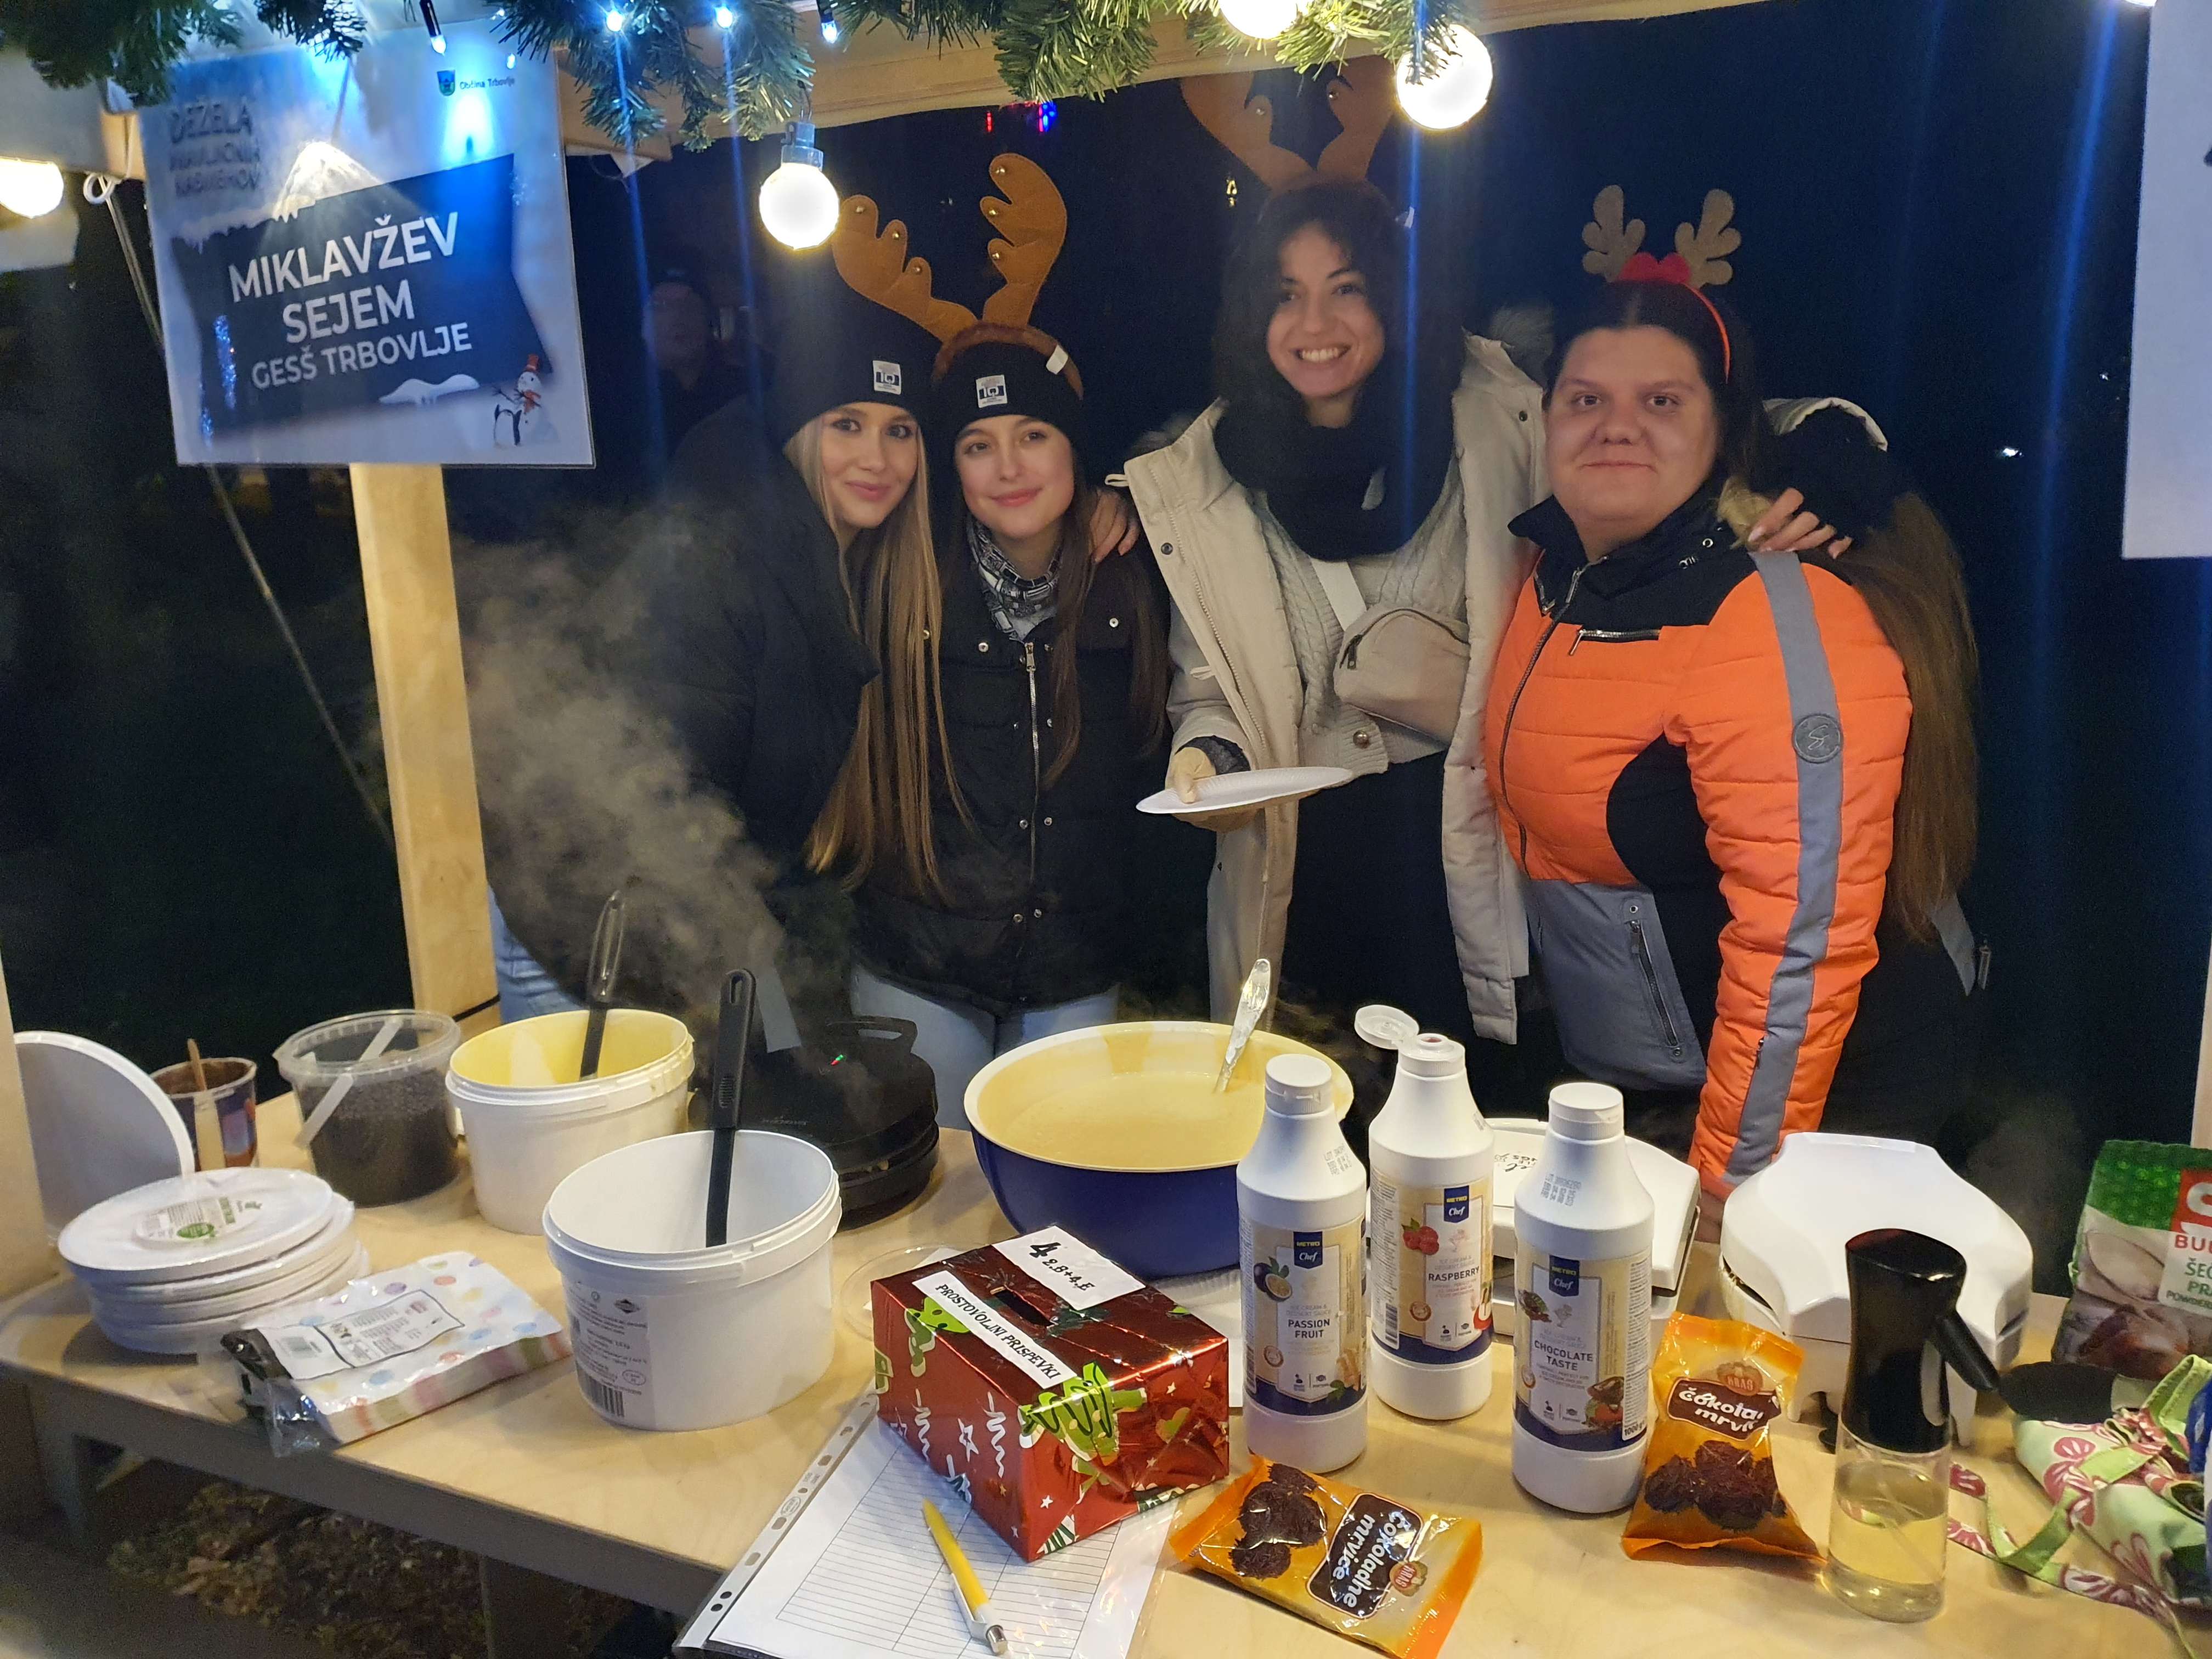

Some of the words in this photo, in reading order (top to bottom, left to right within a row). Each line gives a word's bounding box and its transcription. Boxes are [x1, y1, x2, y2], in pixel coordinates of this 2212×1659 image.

[228, 212, 458, 303] MIKLAVŽEV
[283, 279, 415, 343] SEJEM
[252, 345, 318, 390] GESŠ
[321, 322, 472, 376] TRBOVLJE
[1448, 1206, 1465, 1216] Chef
[1029, 1242, 1062, 1258] 4
[2174, 1234, 2212, 1254] BU
[1299, 1251, 1318, 1262] Chef
[1428, 1266, 1480, 1282] RASPBERRY
[1554, 1277, 1574, 1290] Chef
[935, 1284, 1008, 1337] PROSTOVOLJNI
[1001, 1334, 1062, 1379] PRISPEVKI
[1288, 1319, 1330, 1328] PASSION
[1295, 1329, 1324, 1339] FRUIT
[1534, 1340, 1594, 1362] CHOCOLATE
[1546, 1355, 1578, 1371] TASTE
